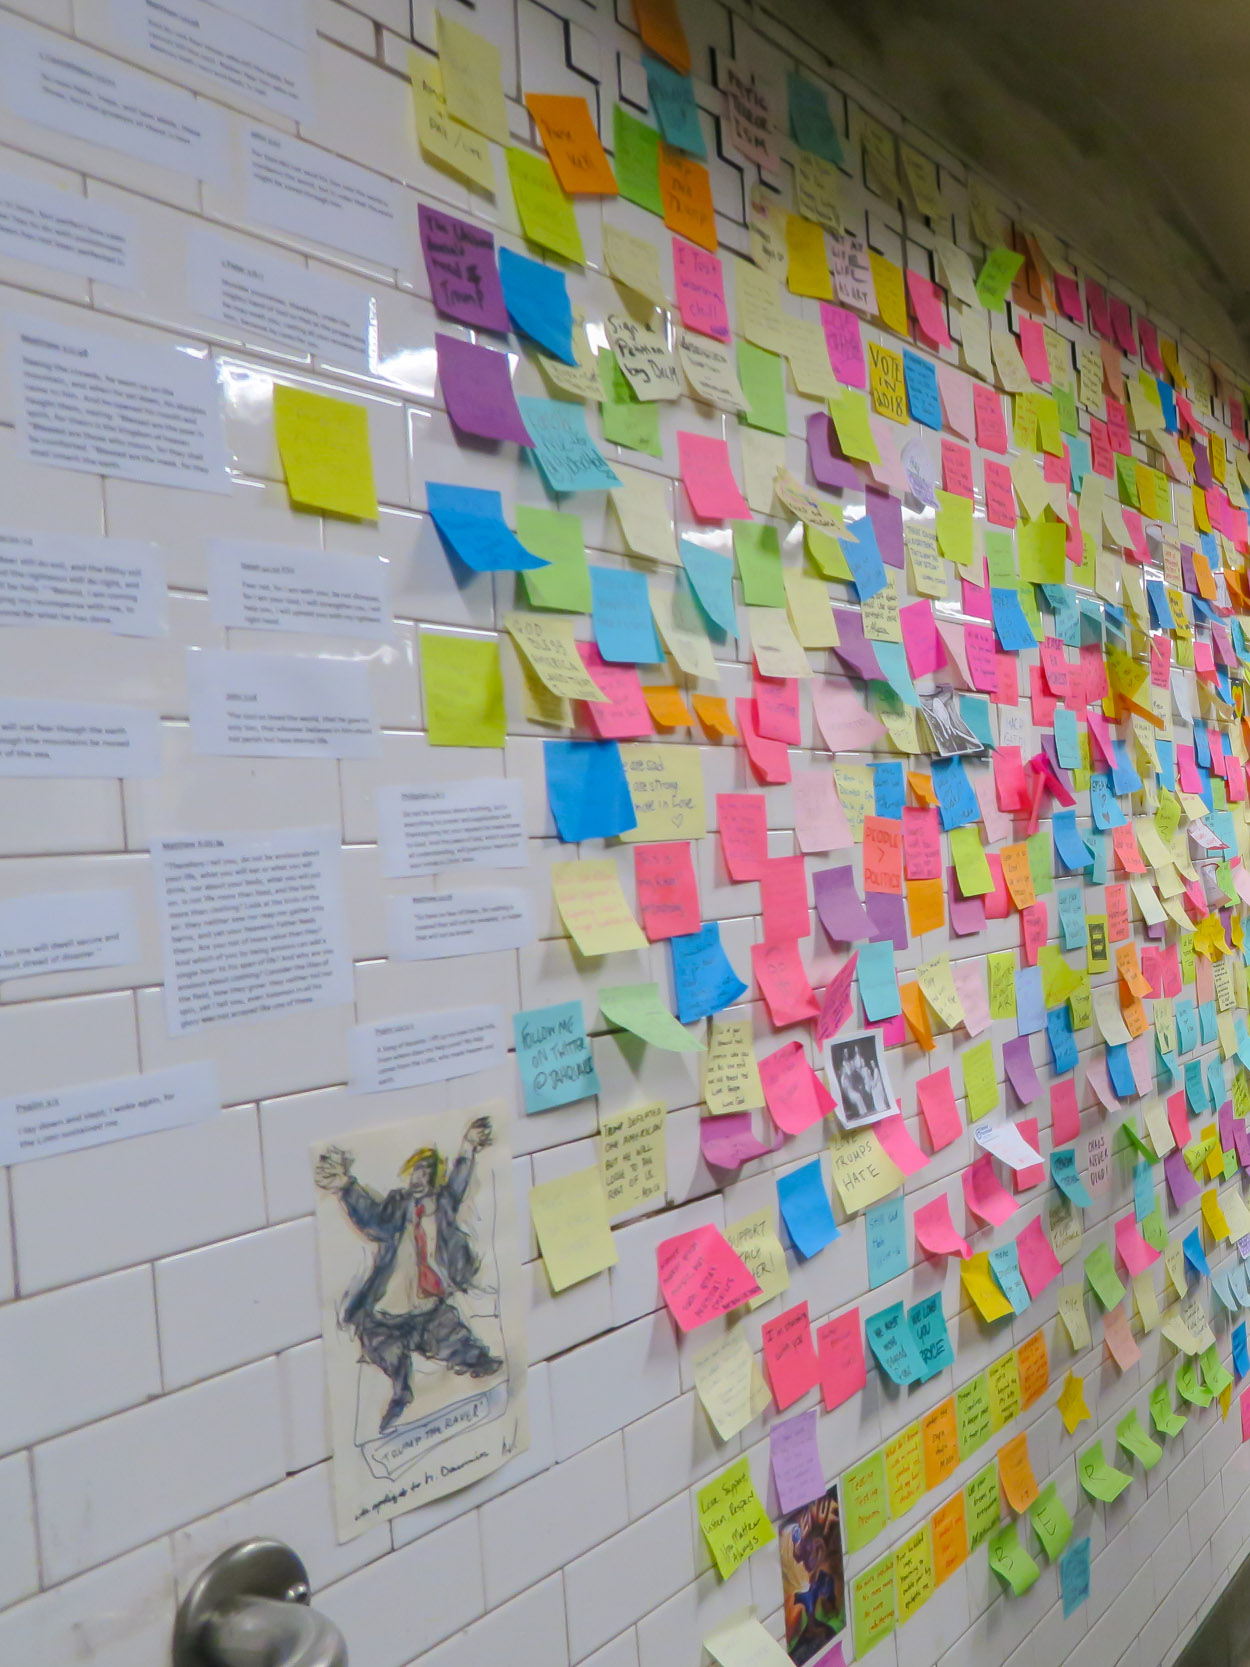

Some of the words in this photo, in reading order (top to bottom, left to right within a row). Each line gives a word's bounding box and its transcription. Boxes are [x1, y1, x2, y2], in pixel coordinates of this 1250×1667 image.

[868, 343, 902, 384] VOTE
[879, 377, 897, 393] IN
[872, 388, 903, 417] 2018
[866, 826, 899, 849] PEOPLE
[865, 868, 900, 889] POLITICS
[521, 1021, 556, 1050] FOLLOW
[557, 1015, 574, 1036] ME
[835, 1141, 873, 1171] TRUMPS
[842, 1163, 881, 1192] HATE
